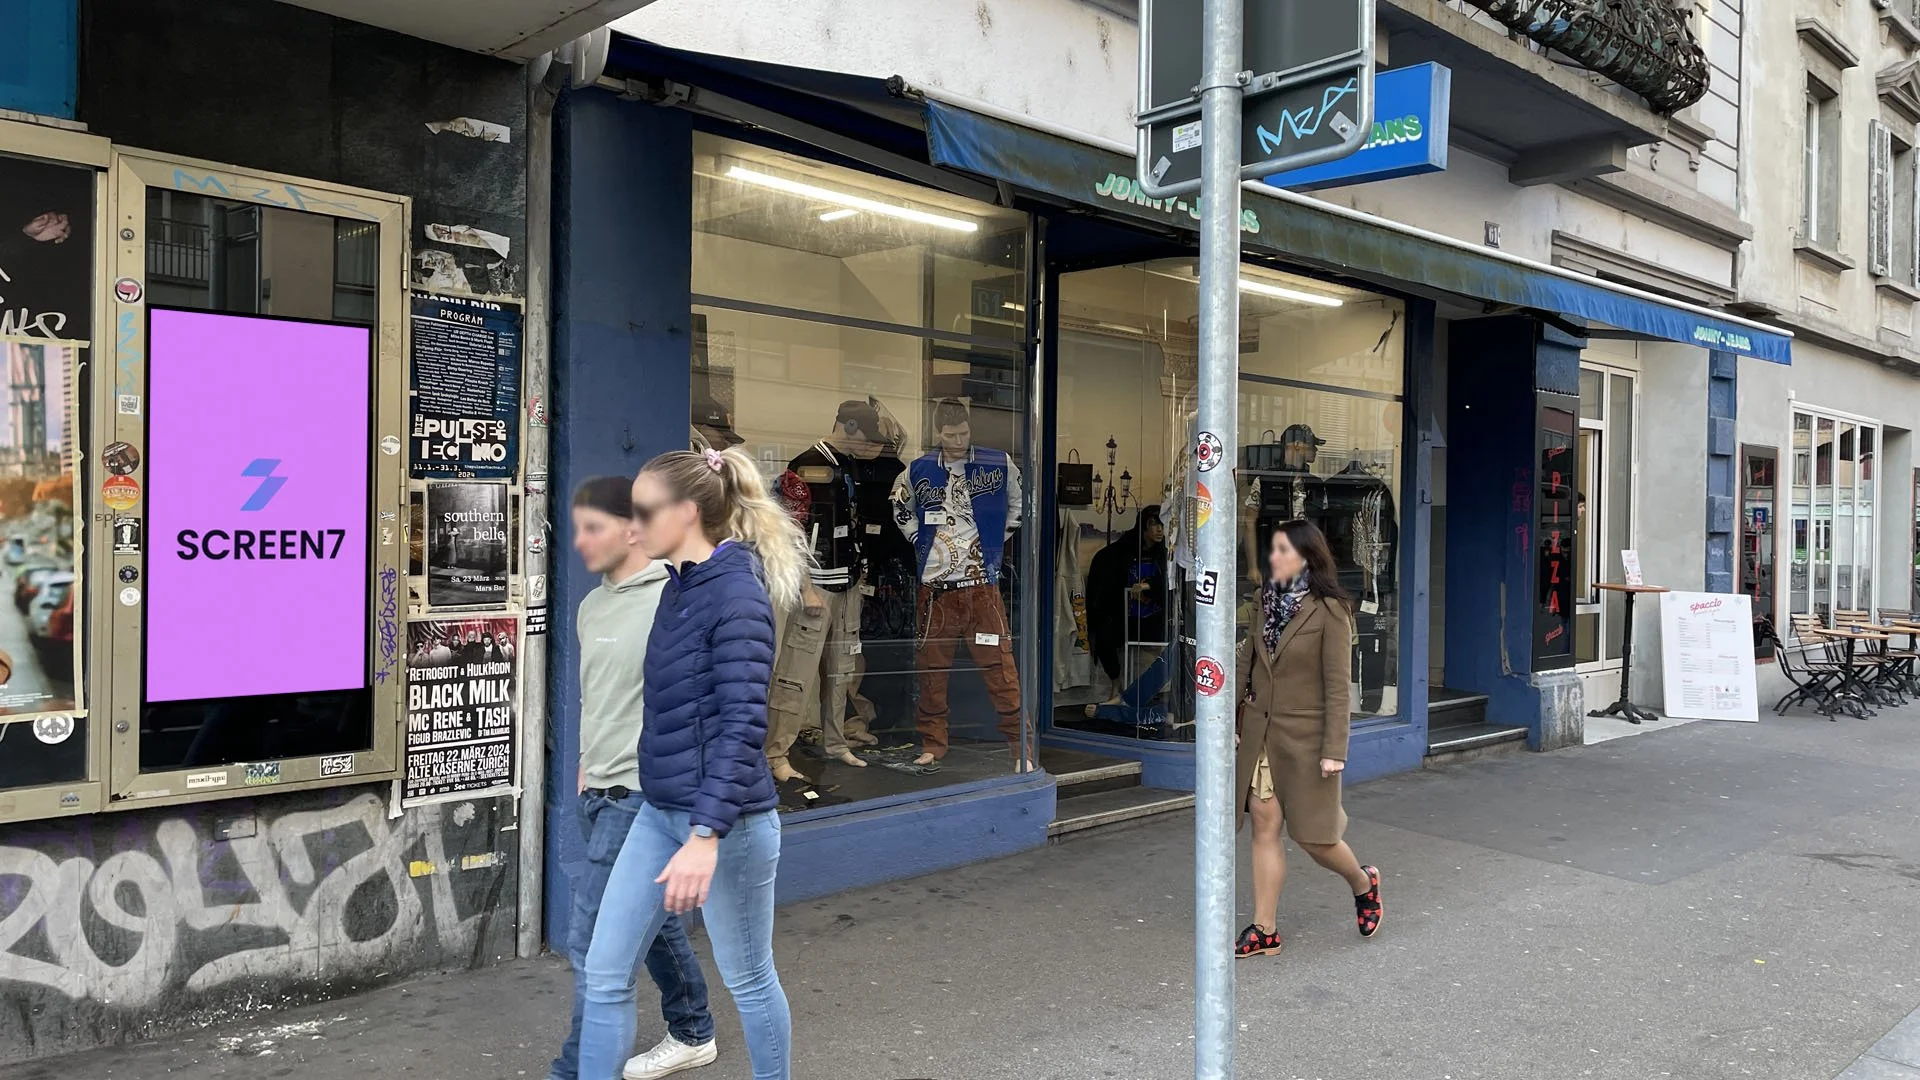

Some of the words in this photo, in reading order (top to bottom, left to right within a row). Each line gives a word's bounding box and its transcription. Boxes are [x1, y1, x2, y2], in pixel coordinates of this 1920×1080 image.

[1360, 114, 1423, 150] ANS
[440, 308, 484, 326] PROGRAM
[444, 508, 504, 523] southern
[176, 529, 346, 560] SCREEN7
[473, 526, 505, 541] belle
[1548, 471, 1561, 613] PIZZA
[1689, 598, 1722, 613] spaccio
[409, 683, 464, 711] BLACK
[468, 678, 510, 705] MILK
[408, 713, 430, 732] MC
[433, 711, 463, 730] RENE
[466, 712, 472, 722] &
[476, 706, 510, 728] TASH
[408, 732, 431, 745] FIGUB
[432, 727, 472, 742] BRAZLEVIC
[408, 751, 445, 767] FREITAG
[488, 743, 510, 758] 2024
[408, 765, 431, 780] ALTE
[432, 759, 477, 777] KASERNE
